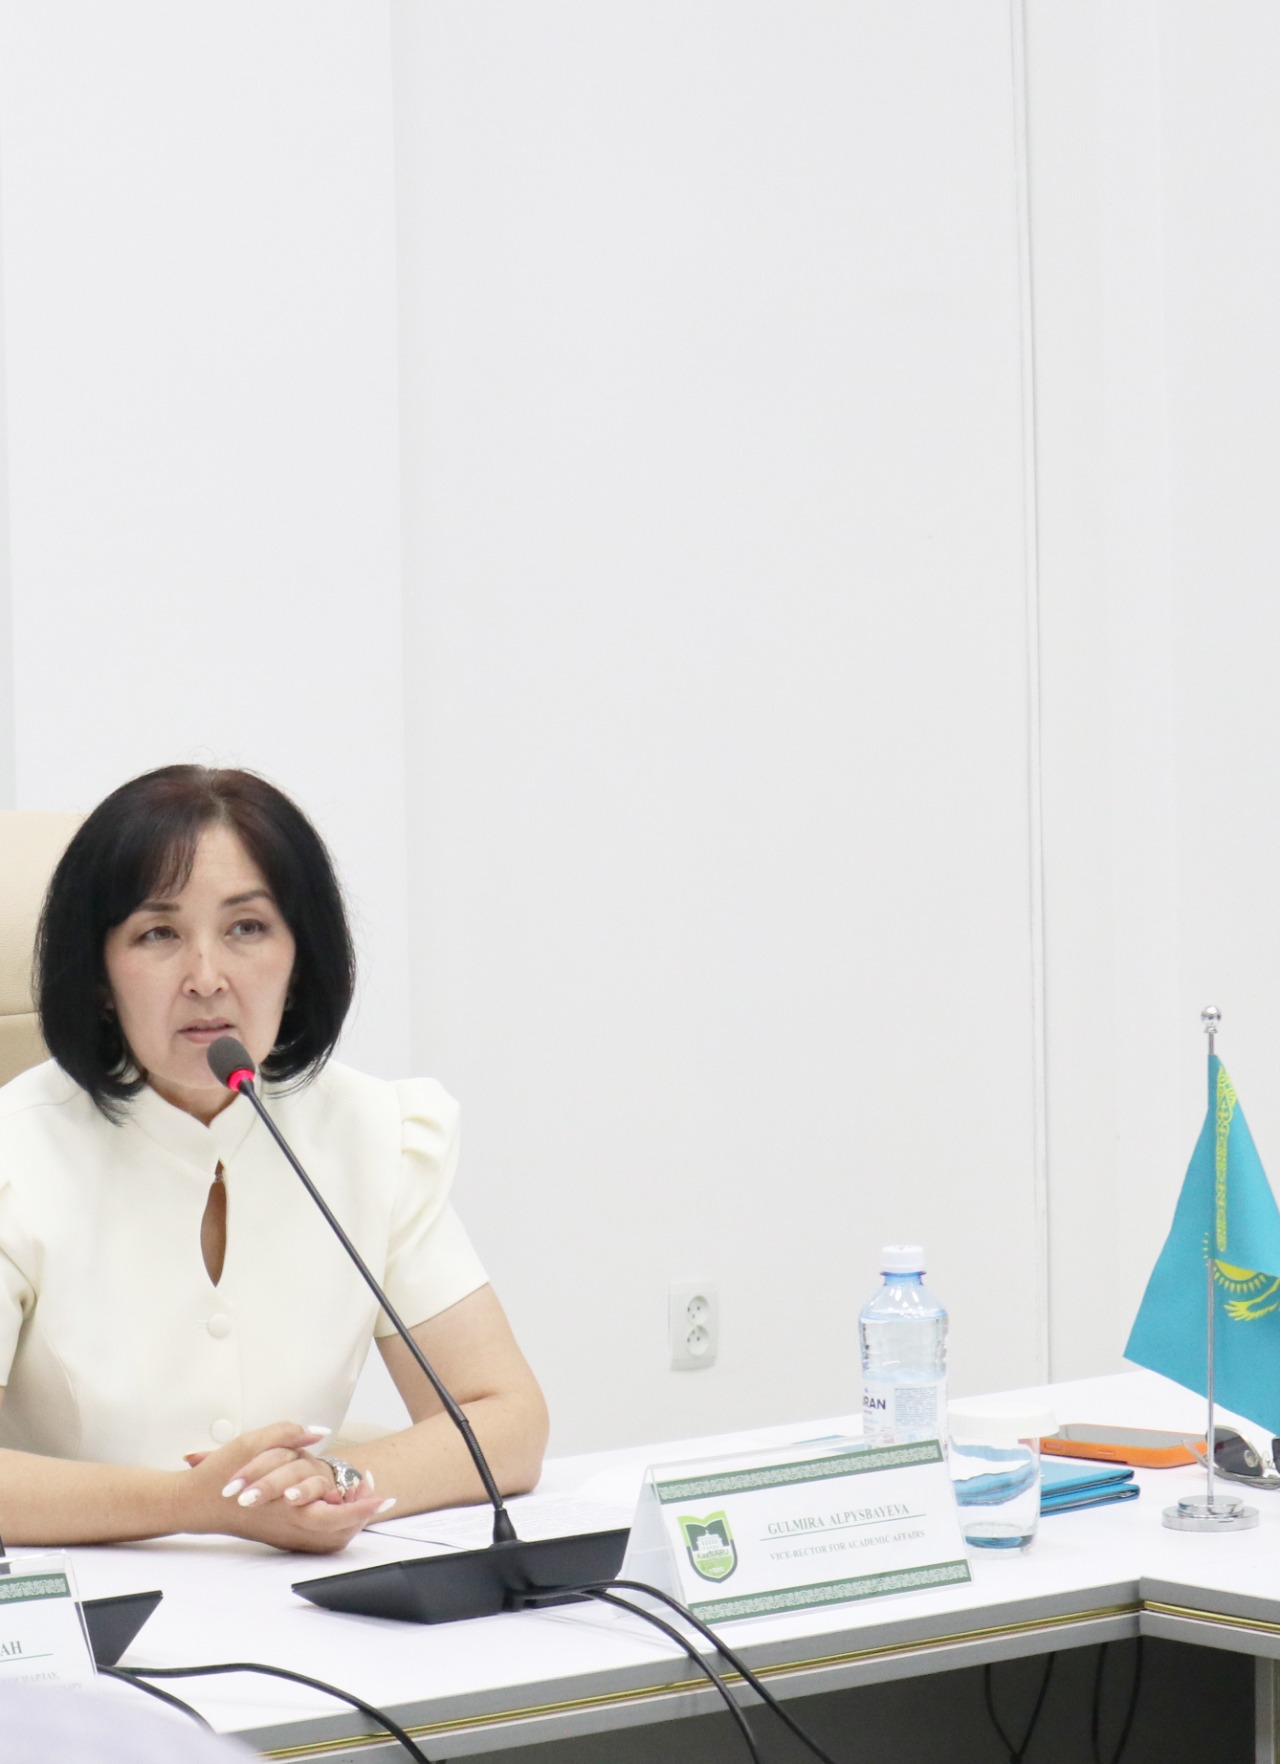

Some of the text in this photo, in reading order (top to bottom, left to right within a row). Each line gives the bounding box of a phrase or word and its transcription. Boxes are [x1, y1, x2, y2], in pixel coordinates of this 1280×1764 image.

[767, 1503, 910, 1535] GULMIRA ALPYSBAYEVA
[769, 1530, 926, 1561] VICE-RECTOR FOR ACADEMIC AFFAIRS
